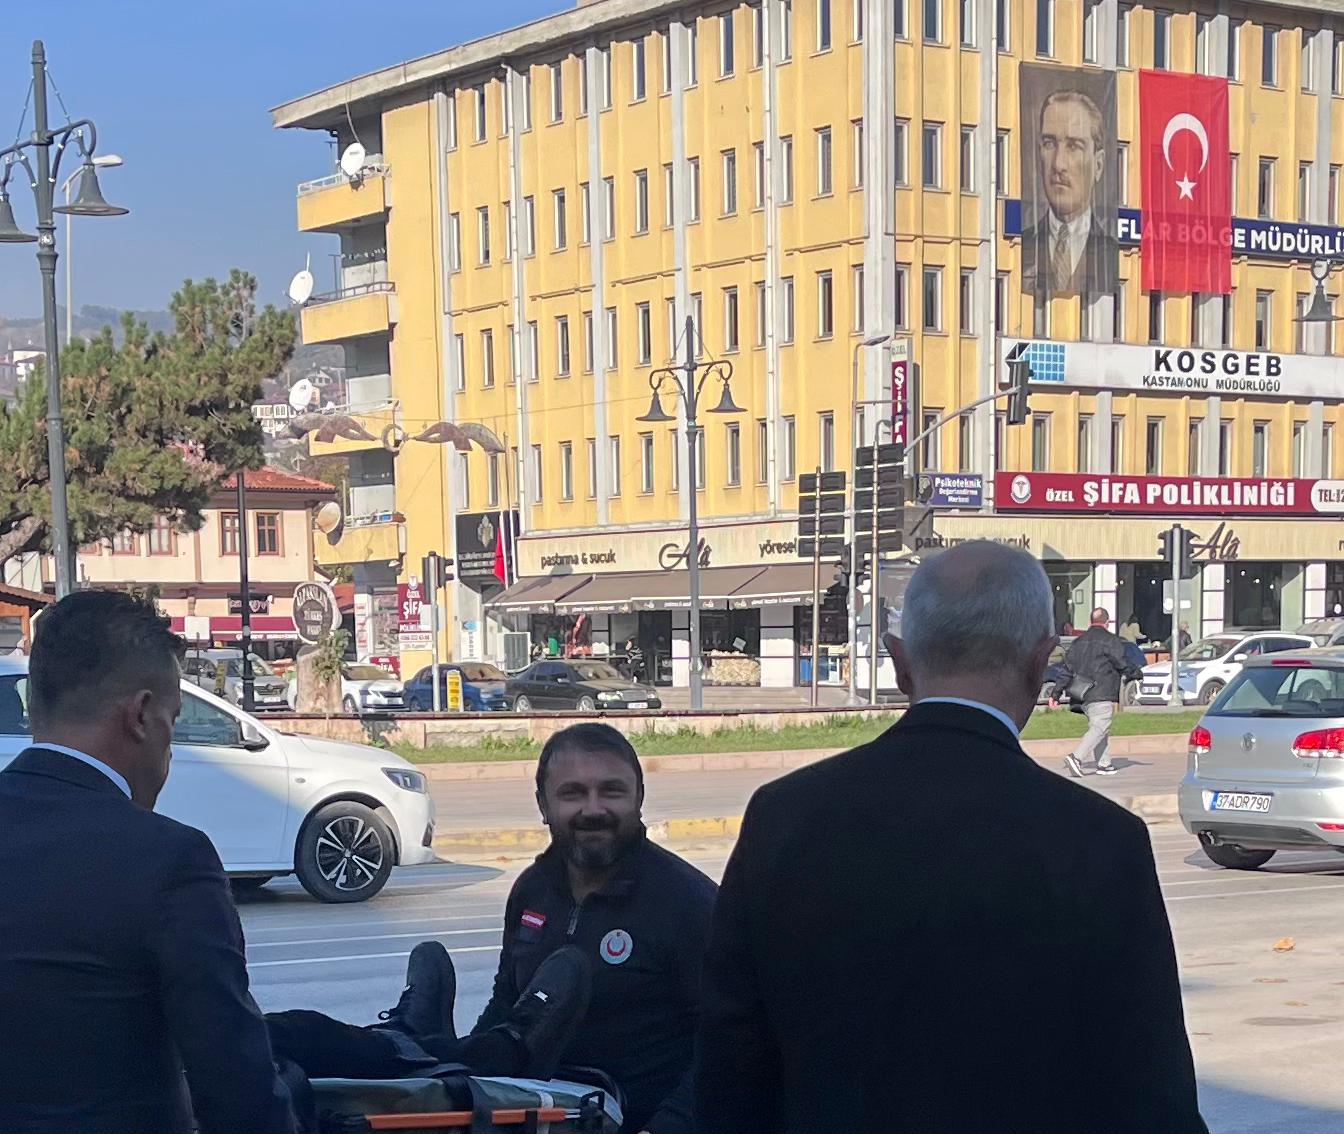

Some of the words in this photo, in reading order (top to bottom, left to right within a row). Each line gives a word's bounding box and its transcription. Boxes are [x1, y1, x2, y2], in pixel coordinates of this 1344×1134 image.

[1154, 349, 1282, 377] KOSGEB
[1045, 487, 1075, 503] ÖZEL
[1082, 478, 1141, 507] ŞİFA
[1146, 480, 1295, 507] POLİKLİNİĞİ
